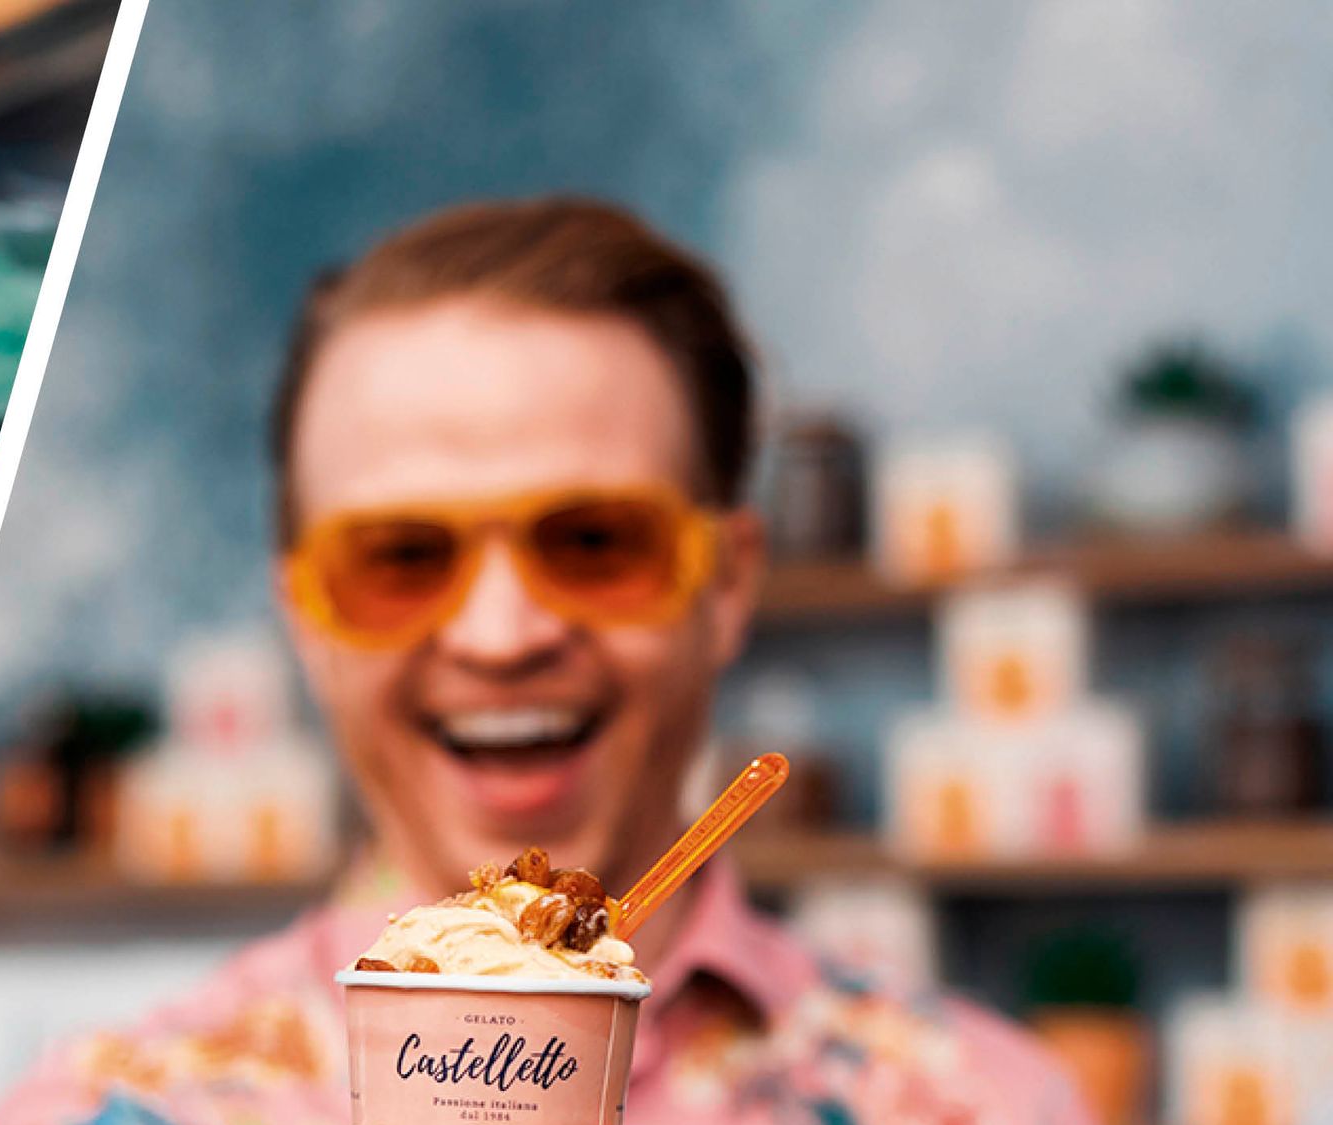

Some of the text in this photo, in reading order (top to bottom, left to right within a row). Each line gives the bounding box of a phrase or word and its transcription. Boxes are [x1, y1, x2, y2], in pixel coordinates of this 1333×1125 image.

[464, 1014, 516, 1025] GELATO
[396, 1033, 579, 1092] Castelletto
[433, 1097, 539, 1111] Passione italiana
